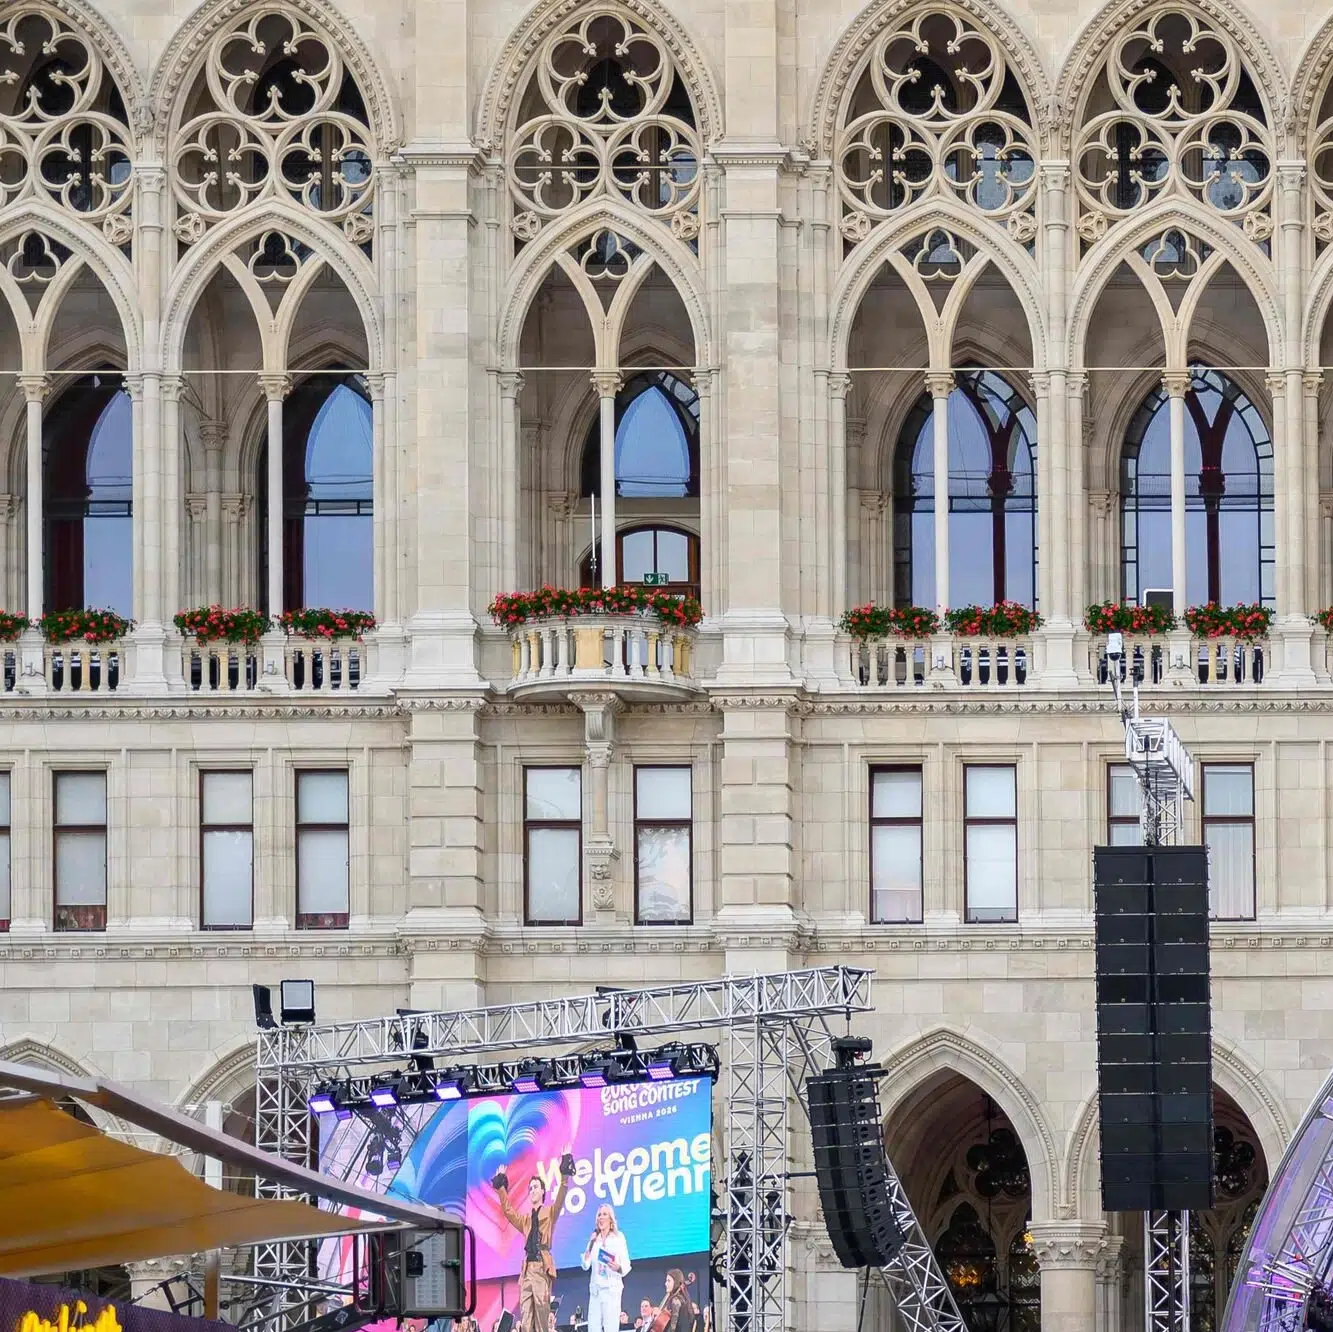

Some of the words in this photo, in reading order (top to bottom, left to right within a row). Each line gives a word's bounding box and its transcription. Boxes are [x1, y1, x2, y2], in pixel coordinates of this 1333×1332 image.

[620, 1111, 653, 1125] VIENNA
[656, 1105, 677, 1117] 2026
[594, 1163, 711, 1206] Vienn
